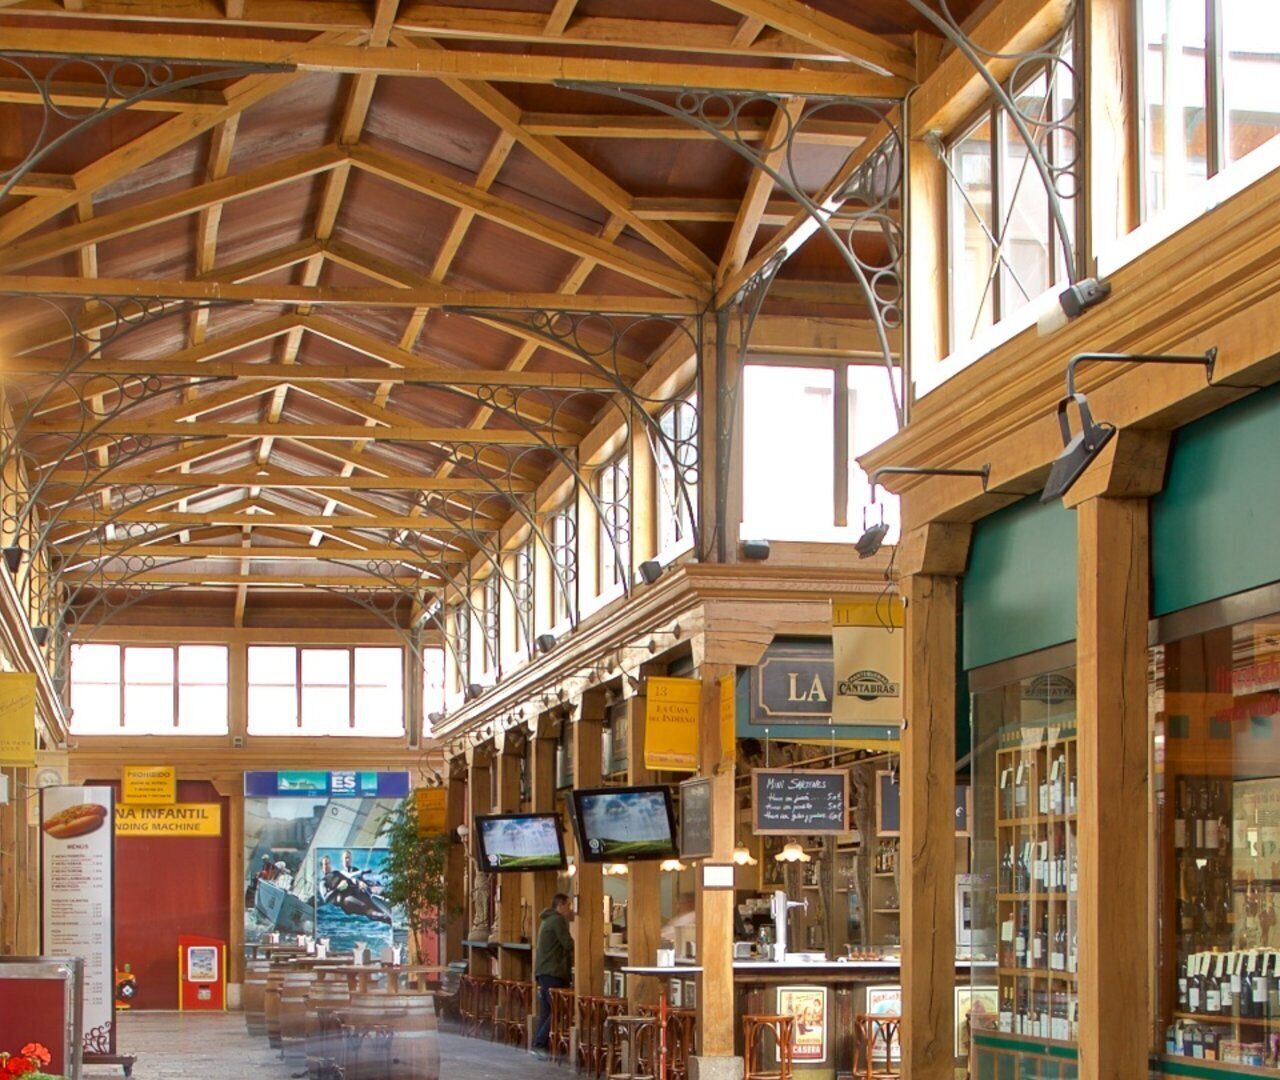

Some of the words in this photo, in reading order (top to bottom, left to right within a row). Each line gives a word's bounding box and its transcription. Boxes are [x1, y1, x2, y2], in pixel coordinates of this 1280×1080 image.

[655, 686, 669, 697] 13
[787, 673, 827, 701] LA
[838, 684, 896, 696] CANTABRAS
[332, 776, 355, 788] ES
[115, 809, 136, 819] NA
[141, 809, 208, 819] INFANTIL
[115, 823, 149, 831] NDING
[151, 823, 201, 831] MACHINE
